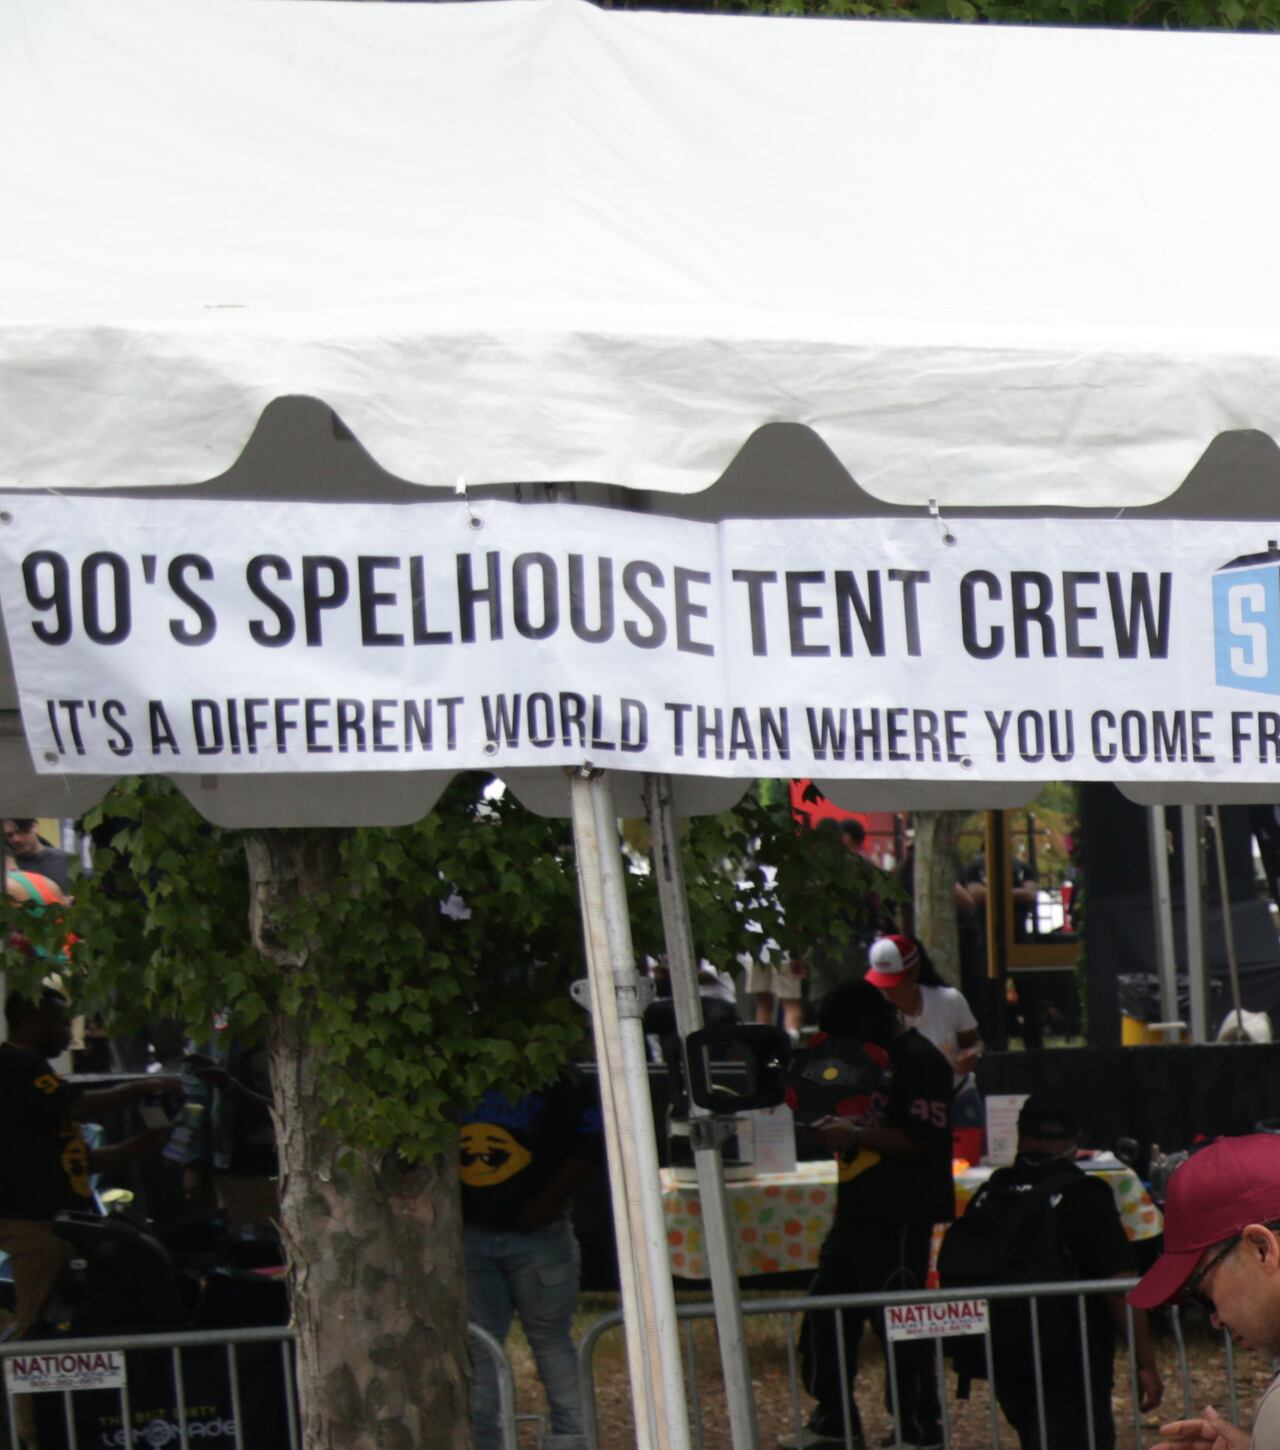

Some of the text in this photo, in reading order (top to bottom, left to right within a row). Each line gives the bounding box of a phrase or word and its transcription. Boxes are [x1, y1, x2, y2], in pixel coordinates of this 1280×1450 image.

[22, 550, 1173, 660] 90'S SPELHOUSE TENT CREW
[47, 699, 134, 757] IT'S
[148, 699, 181, 756] A
[190, 696, 465, 756] DIFFERENT
[481, 691, 649, 754] WORLD
[664, 702, 790, 760] THAN
[806, 707, 969, 763] WHERE
[984, 709, 1075, 763] YOU
[1090, 709, 1216, 764] COME
[890, 1300, 984, 1324] NATIONAL
[12, 1353, 121, 1376] NATIONAL
